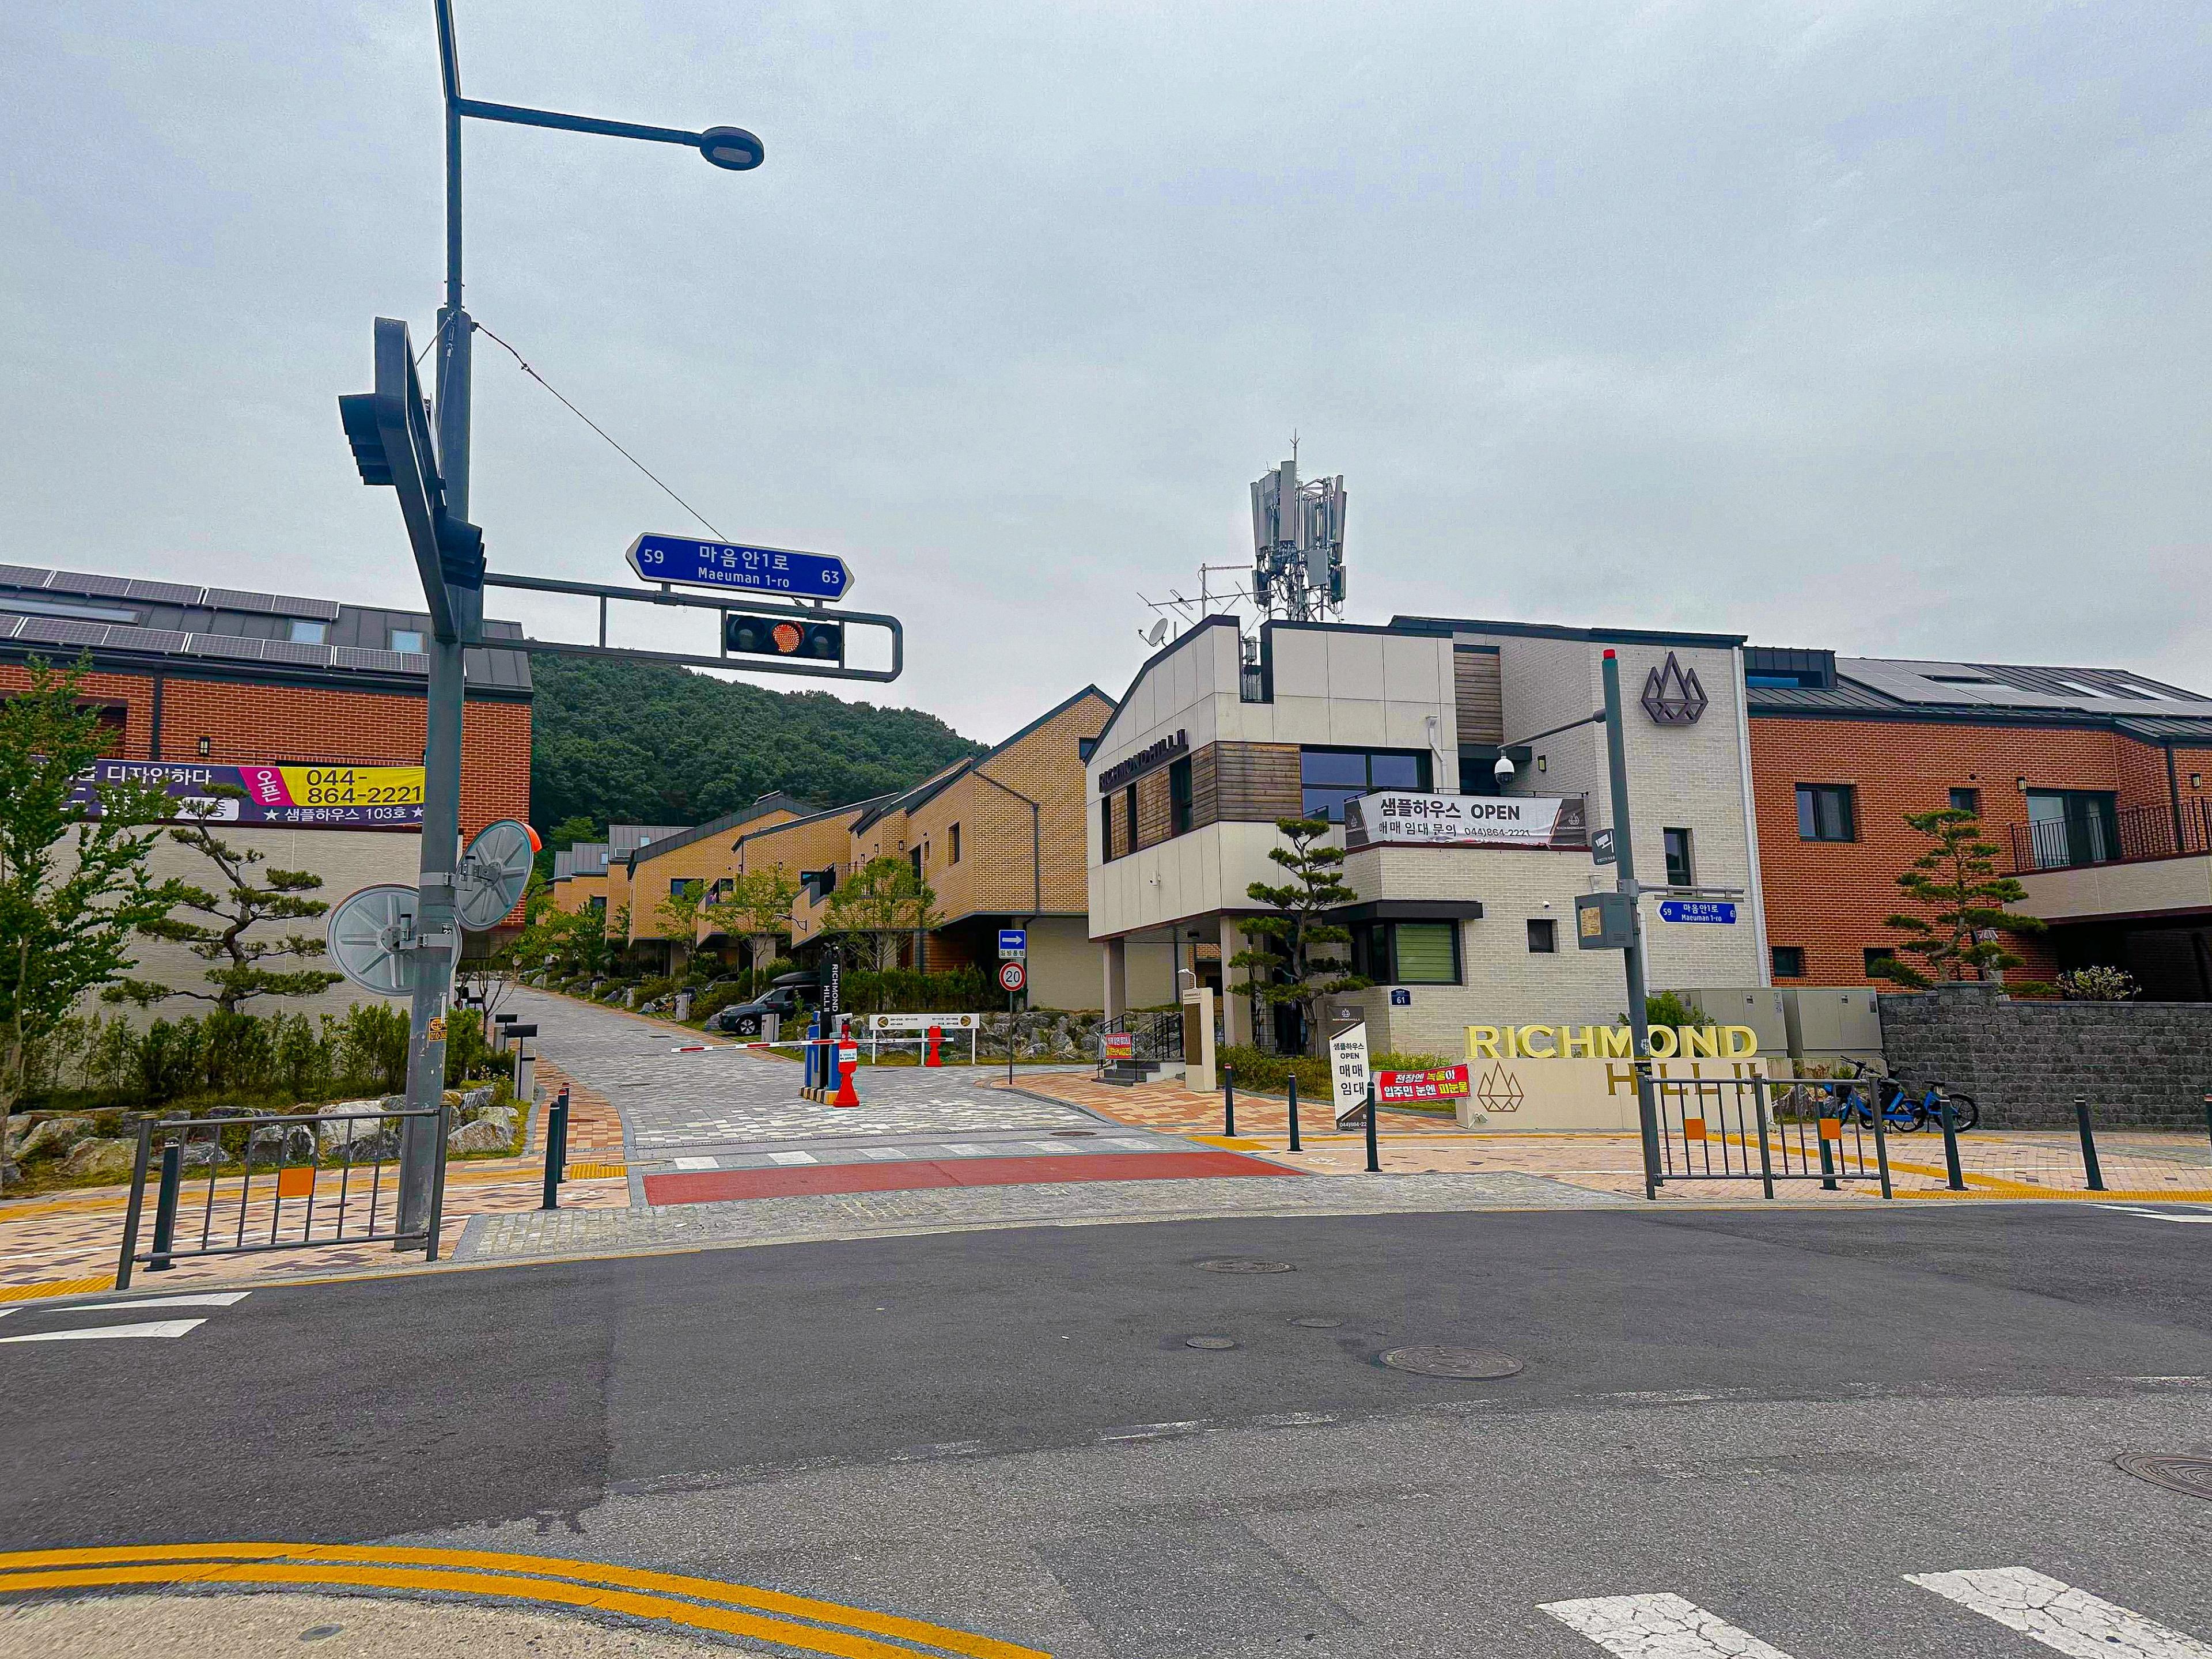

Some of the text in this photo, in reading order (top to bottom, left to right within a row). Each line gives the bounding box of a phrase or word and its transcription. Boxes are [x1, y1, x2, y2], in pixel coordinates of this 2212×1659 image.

[644, 548, 664, 564] 59
[699, 546, 790, 571] 마음안1로
[698, 567, 790, 588] Maeuman 1-ro
[821, 570, 840, 584] 63
[257, 770, 281, 802] 오픈
[306, 770, 368, 786] 044-
[308, 786, 421, 804] 864-2221
[285, 806, 407, 821] 샘플하우스 103호
[1381, 798, 1520, 820] 샘플하우스 OPEN
[1379, 821, 1400, 834] 매매
[1405, 822, 1429, 835] 임대
[1433, 824, 1456, 836] 문의
[1464, 827, 1530, 836] 044)864-2221
[1683, 904, 1718, 914] 마음안1로
[1006, 971, 1020, 983] 20
[1463, 1024, 1758, 1059] RICHMOND
[1605, 1063, 1719, 1096] HLL
[1384, 1081, 1468, 1097] 입주민 눈엔 피눈물
